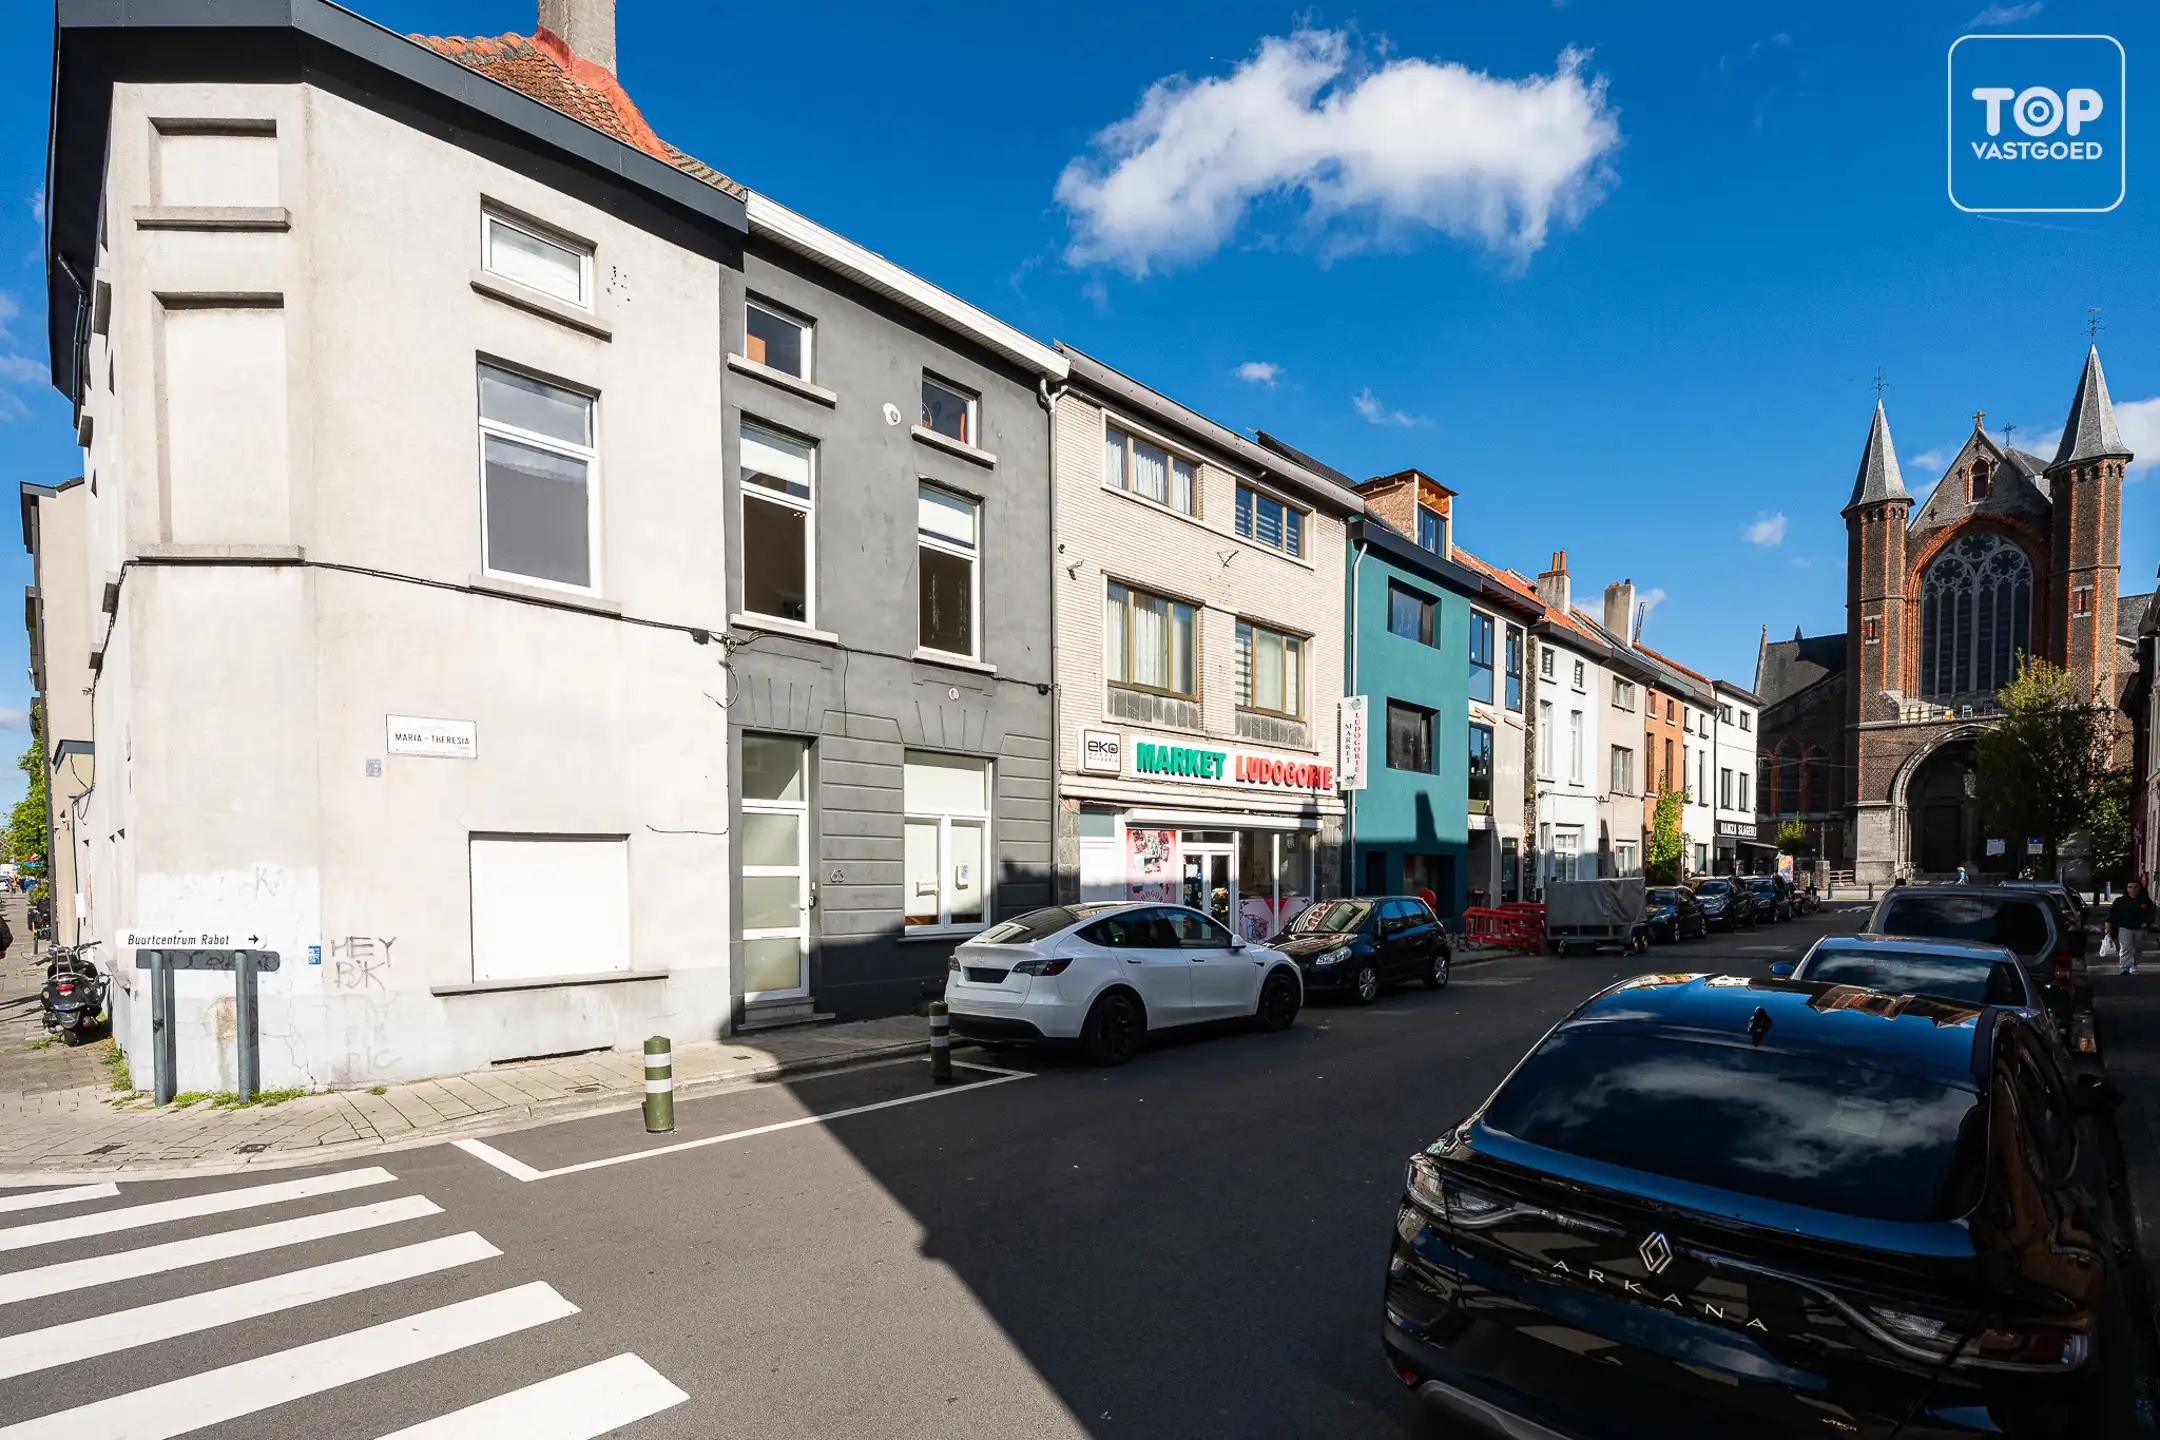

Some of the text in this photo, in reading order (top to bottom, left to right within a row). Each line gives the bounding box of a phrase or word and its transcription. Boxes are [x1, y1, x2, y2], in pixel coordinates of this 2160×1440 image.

[395, 732, 423, 743] MARIA
[431, 734, 470, 745] THERESIA
[1087, 740, 1119, 755] eko
[1353, 712, 1361, 773] LUDOGORIE
[1136, 742, 1334, 790] MARKET LUDOGORIE
[127, 934, 230, 945] Buurtcentrum Rabot
[330, 936, 397, 968] HEY
[1553, 1259, 1768, 1332] ARKANA
